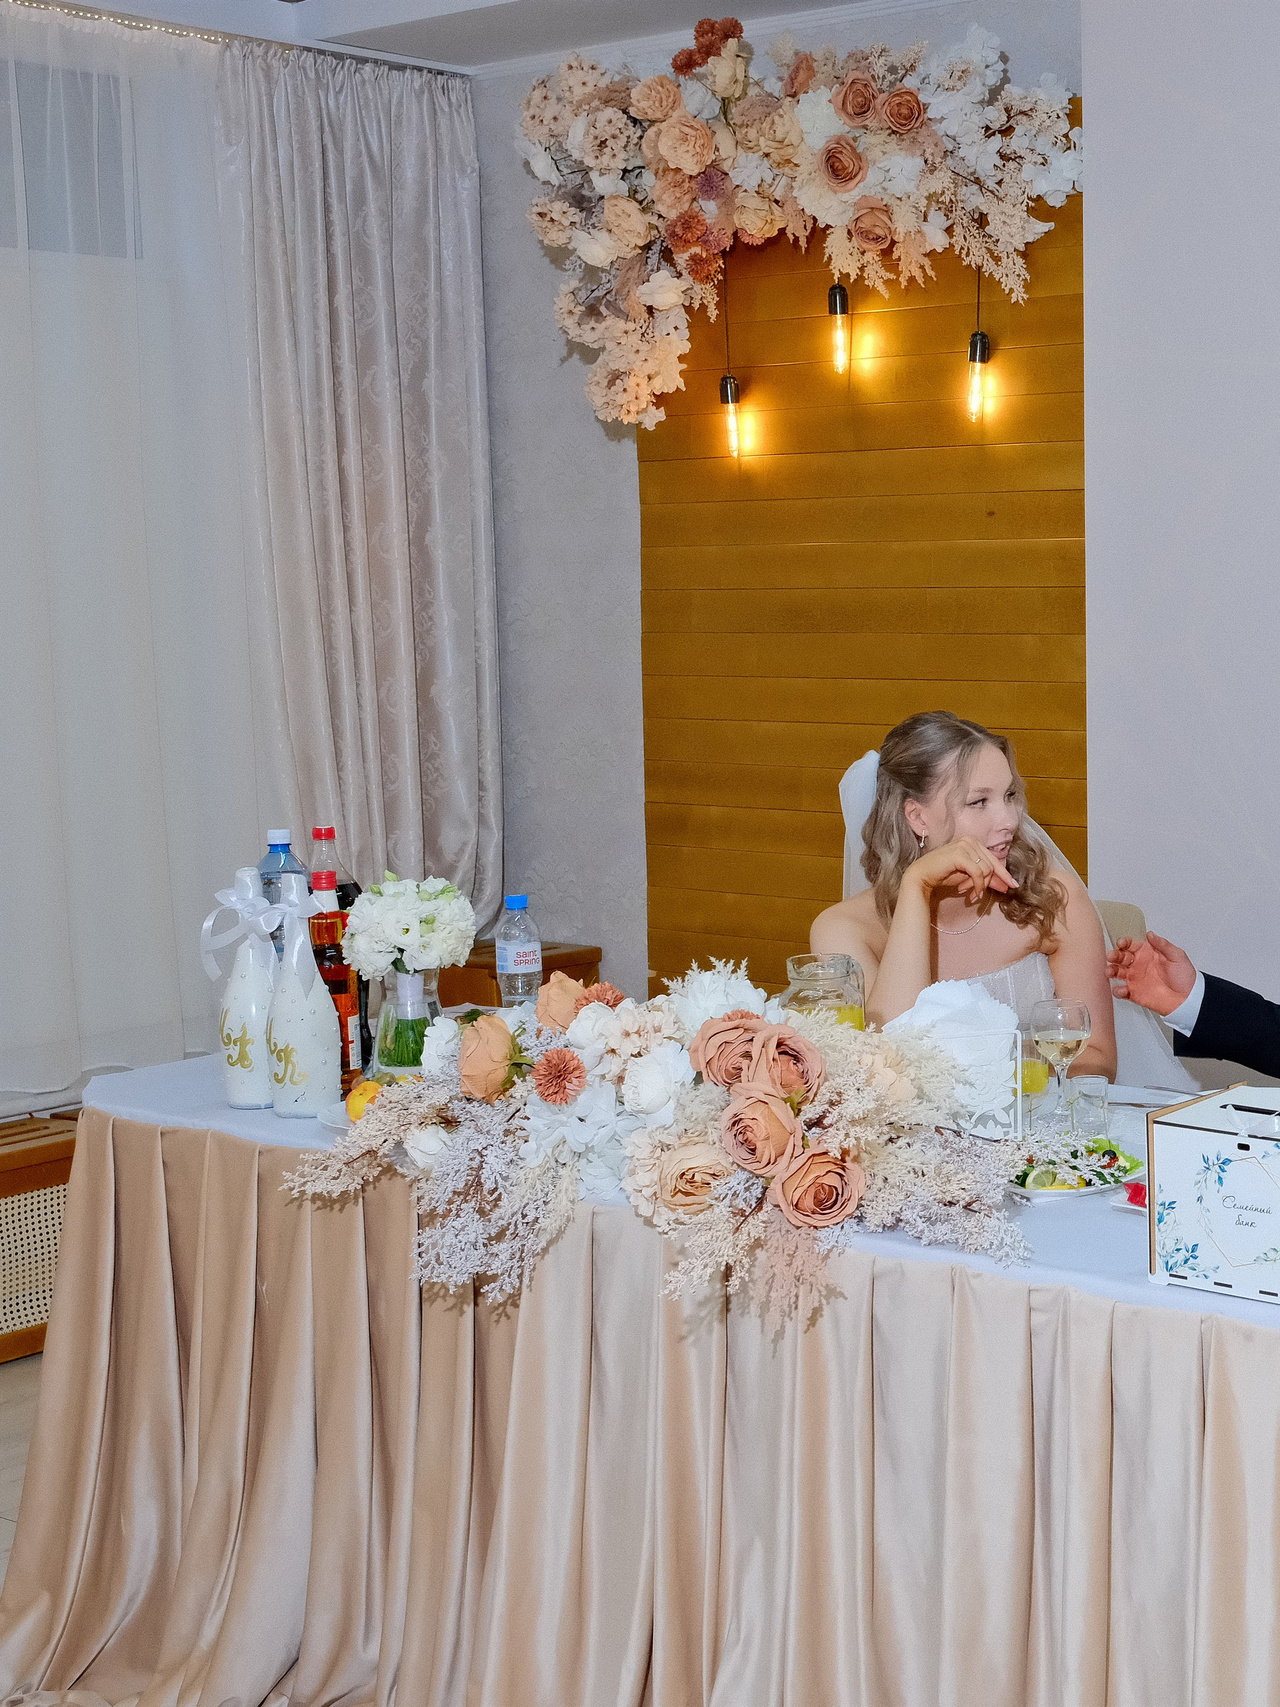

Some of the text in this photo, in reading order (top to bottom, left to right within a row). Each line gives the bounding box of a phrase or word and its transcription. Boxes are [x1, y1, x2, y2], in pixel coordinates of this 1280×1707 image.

[515, 950, 538, 959] saint
[513, 957, 540, 967] SPRING
[1222, 1195, 1273, 1215] Семейный
[1234, 1213, 1257, 1228] банк
